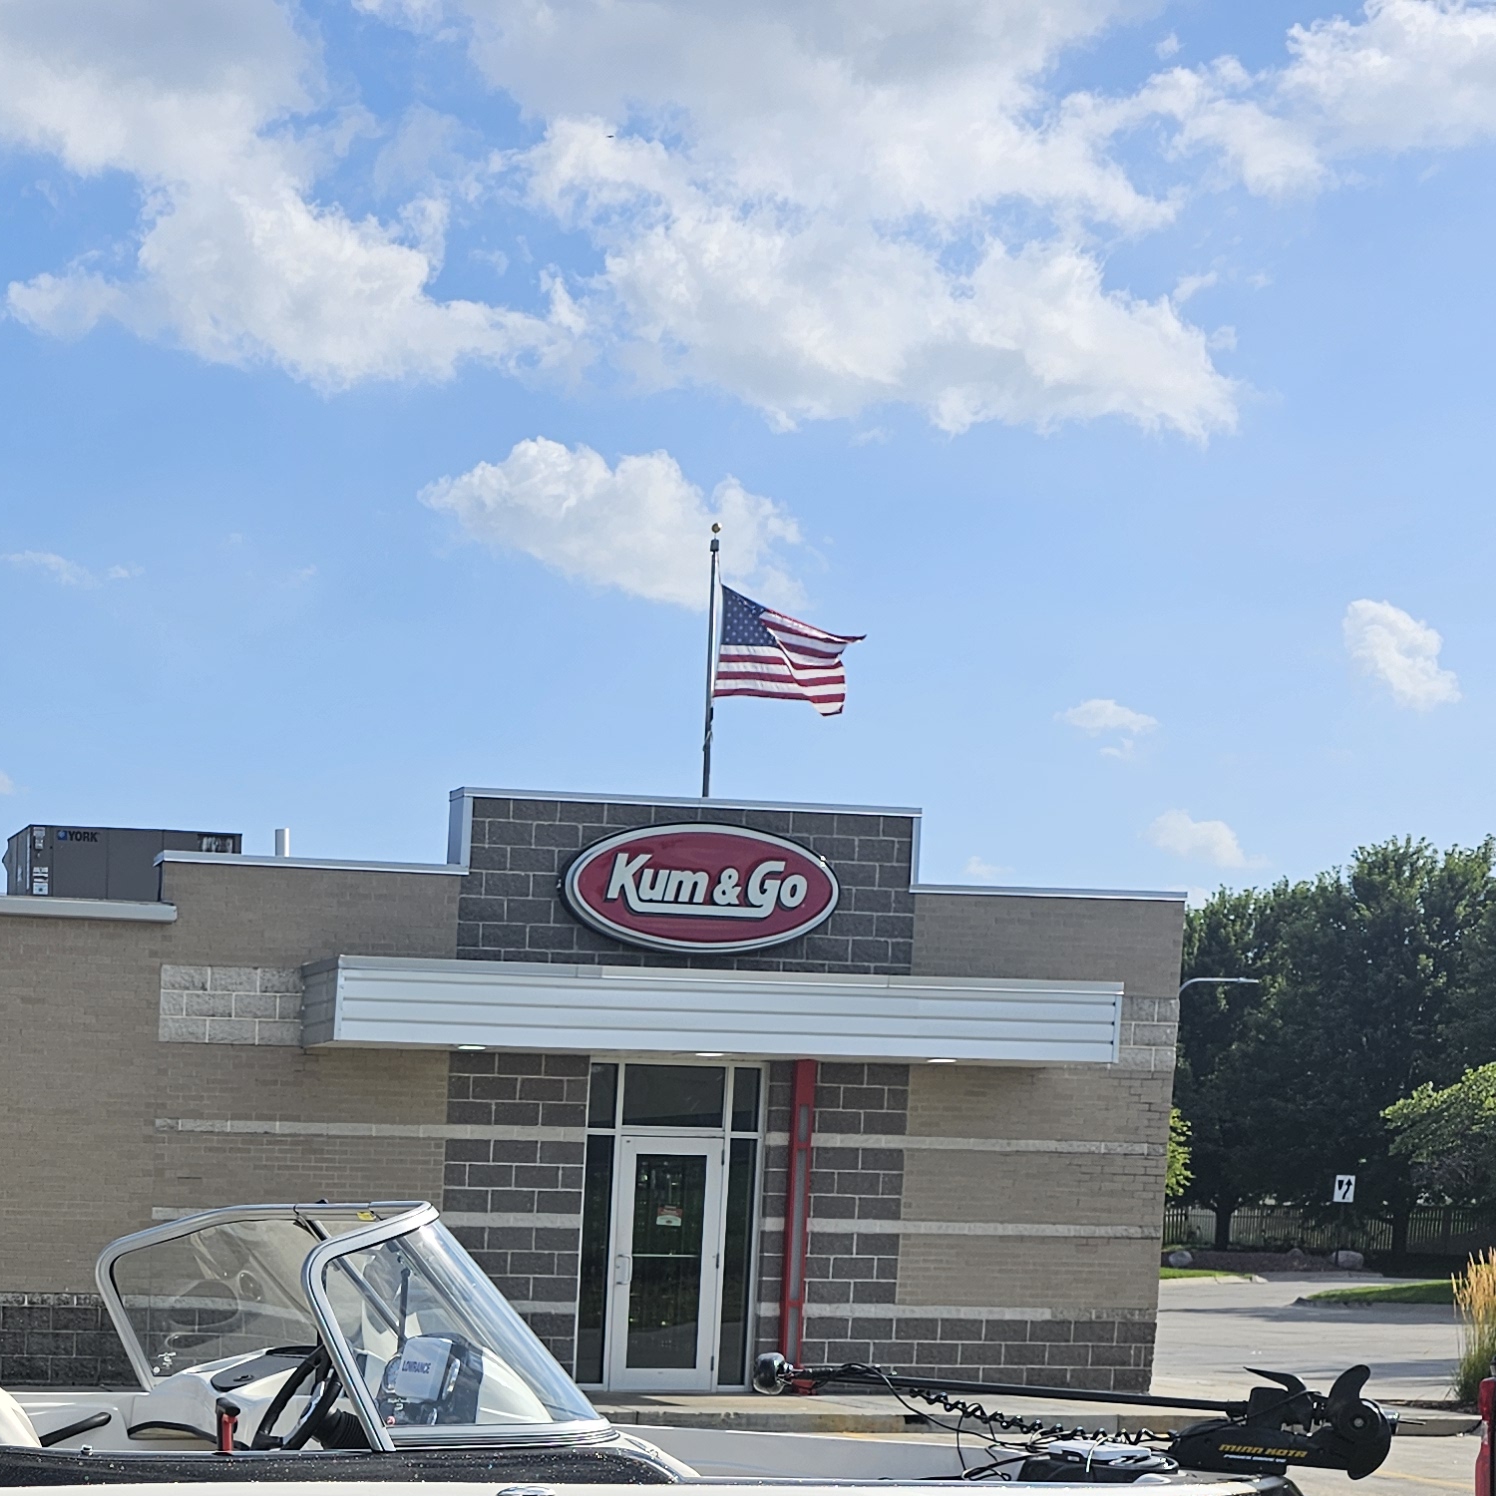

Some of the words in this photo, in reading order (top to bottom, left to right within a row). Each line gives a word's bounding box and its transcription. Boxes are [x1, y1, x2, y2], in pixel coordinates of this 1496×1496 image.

[66, 831, 98, 843] YORK
[607, 853, 709, 912] Kum
[713, 868, 742, 905] &
[747, 861, 808, 918] Go
[1265, 1447, 1308, 1458] KOTA
